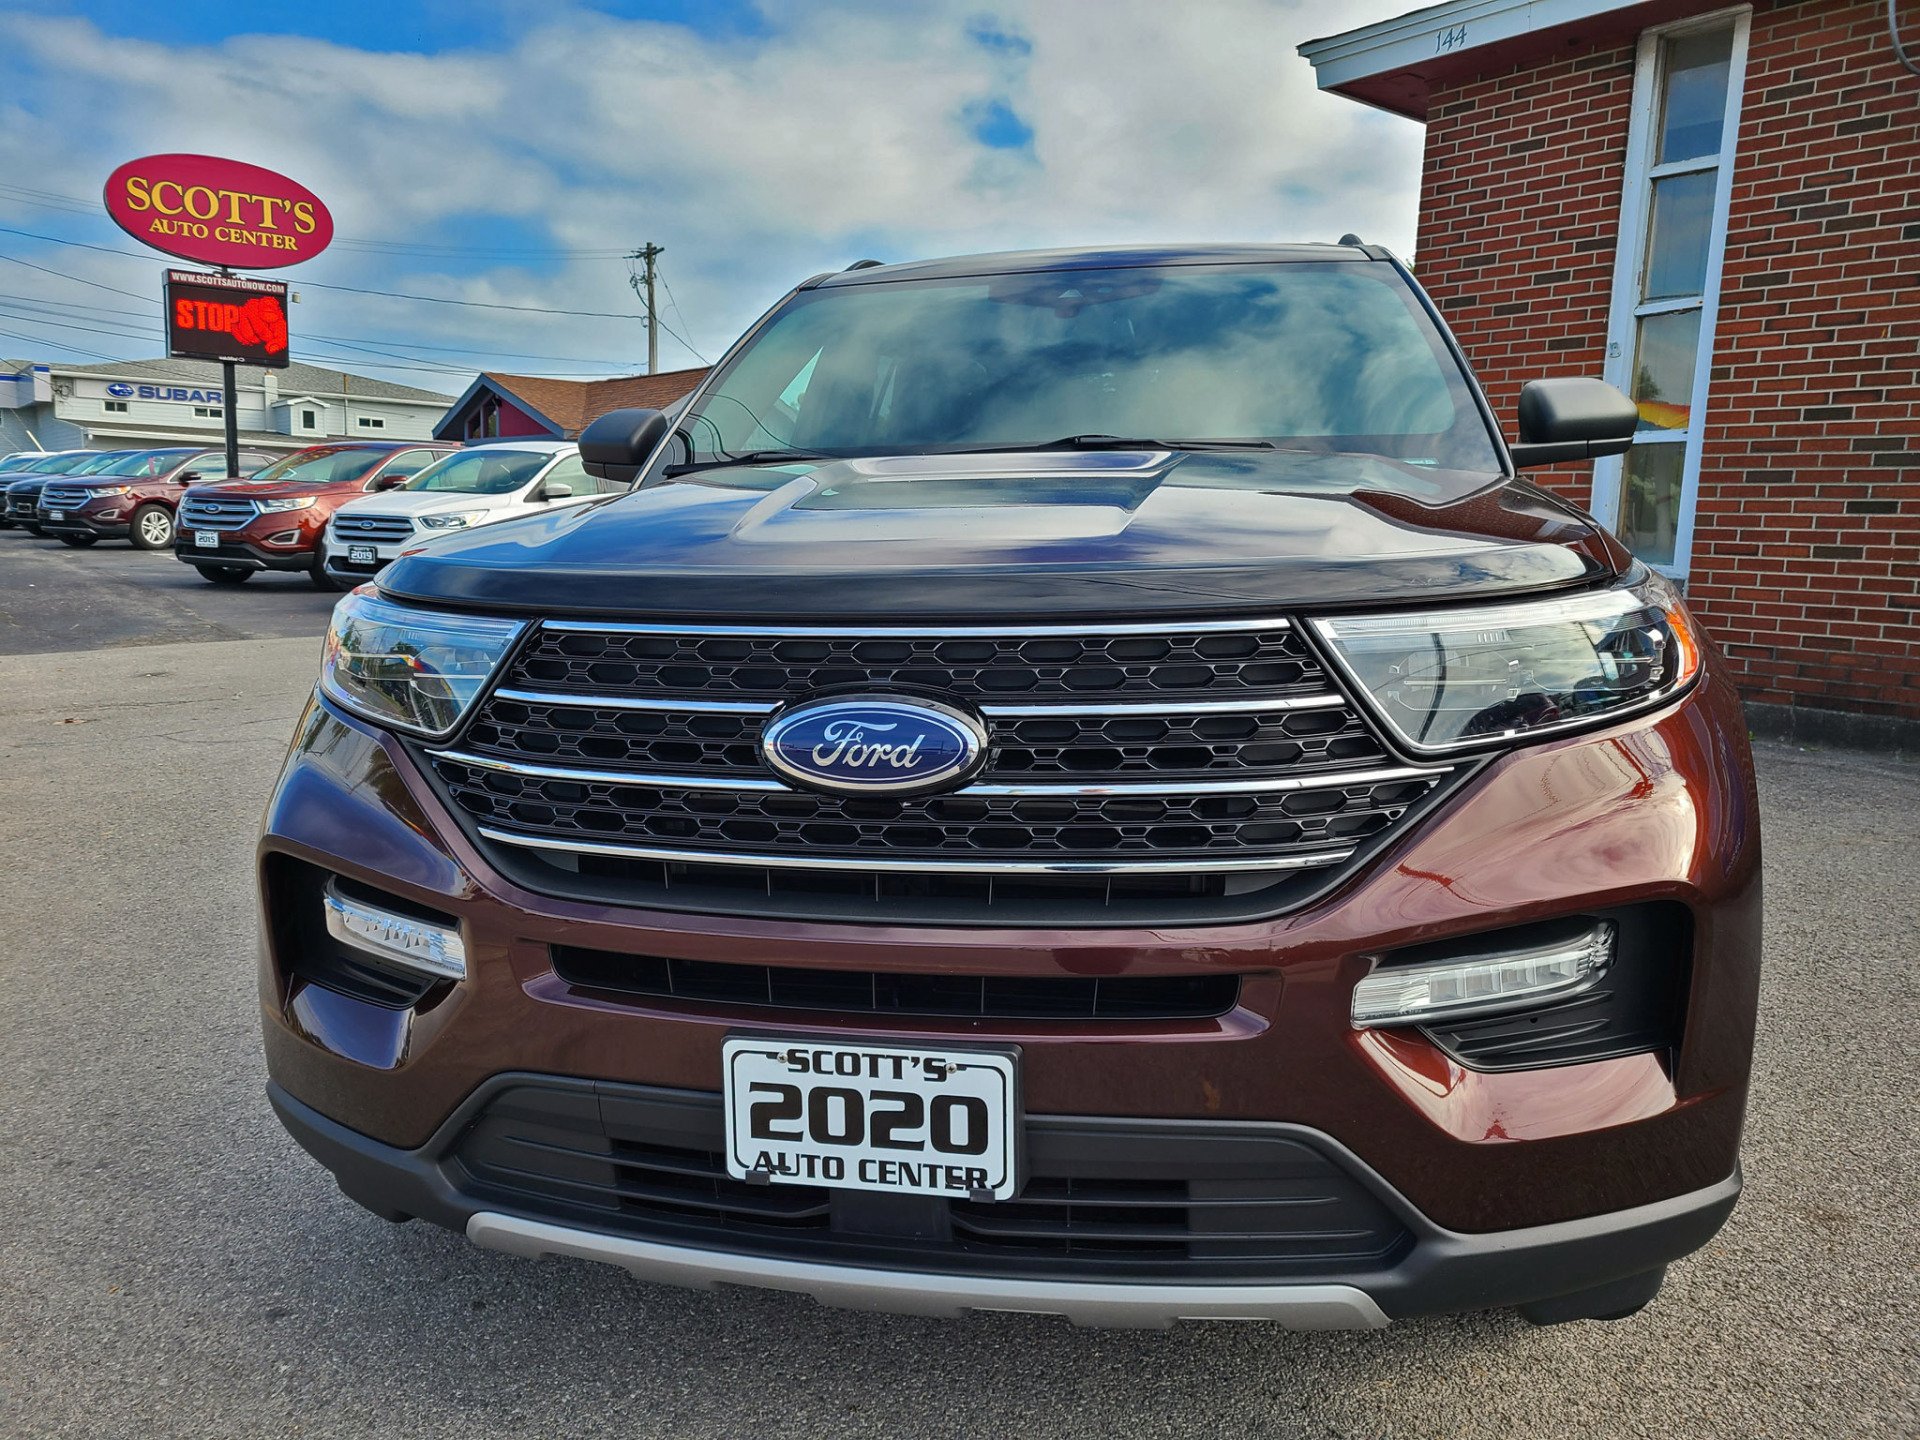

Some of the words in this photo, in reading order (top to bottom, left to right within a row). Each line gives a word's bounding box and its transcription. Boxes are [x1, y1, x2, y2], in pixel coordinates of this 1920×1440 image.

[1435, 24, 1467, 54] 144
[126, 176, 316, 234] SCOTT'S
[149, 218, 209, 239] AUTO
[214, 226, 299, 251] CENTER
[171, 271, 285, 294] WWW.SCOTTSAUTONOW.COM
[176, 298, 239, 333] STOP
[138, 385, 237, 404] SUBAR
[350, 550, 373, 560] 2019
[812, 720, 925, 768] Ford
[787, 1048, 947, 1083] SCOTT'S
[748, 1081, 989, 1156] 2020
[753, 1150, 845, 1181] AUTO
[858, 1158, 989, 1191] CENTER
